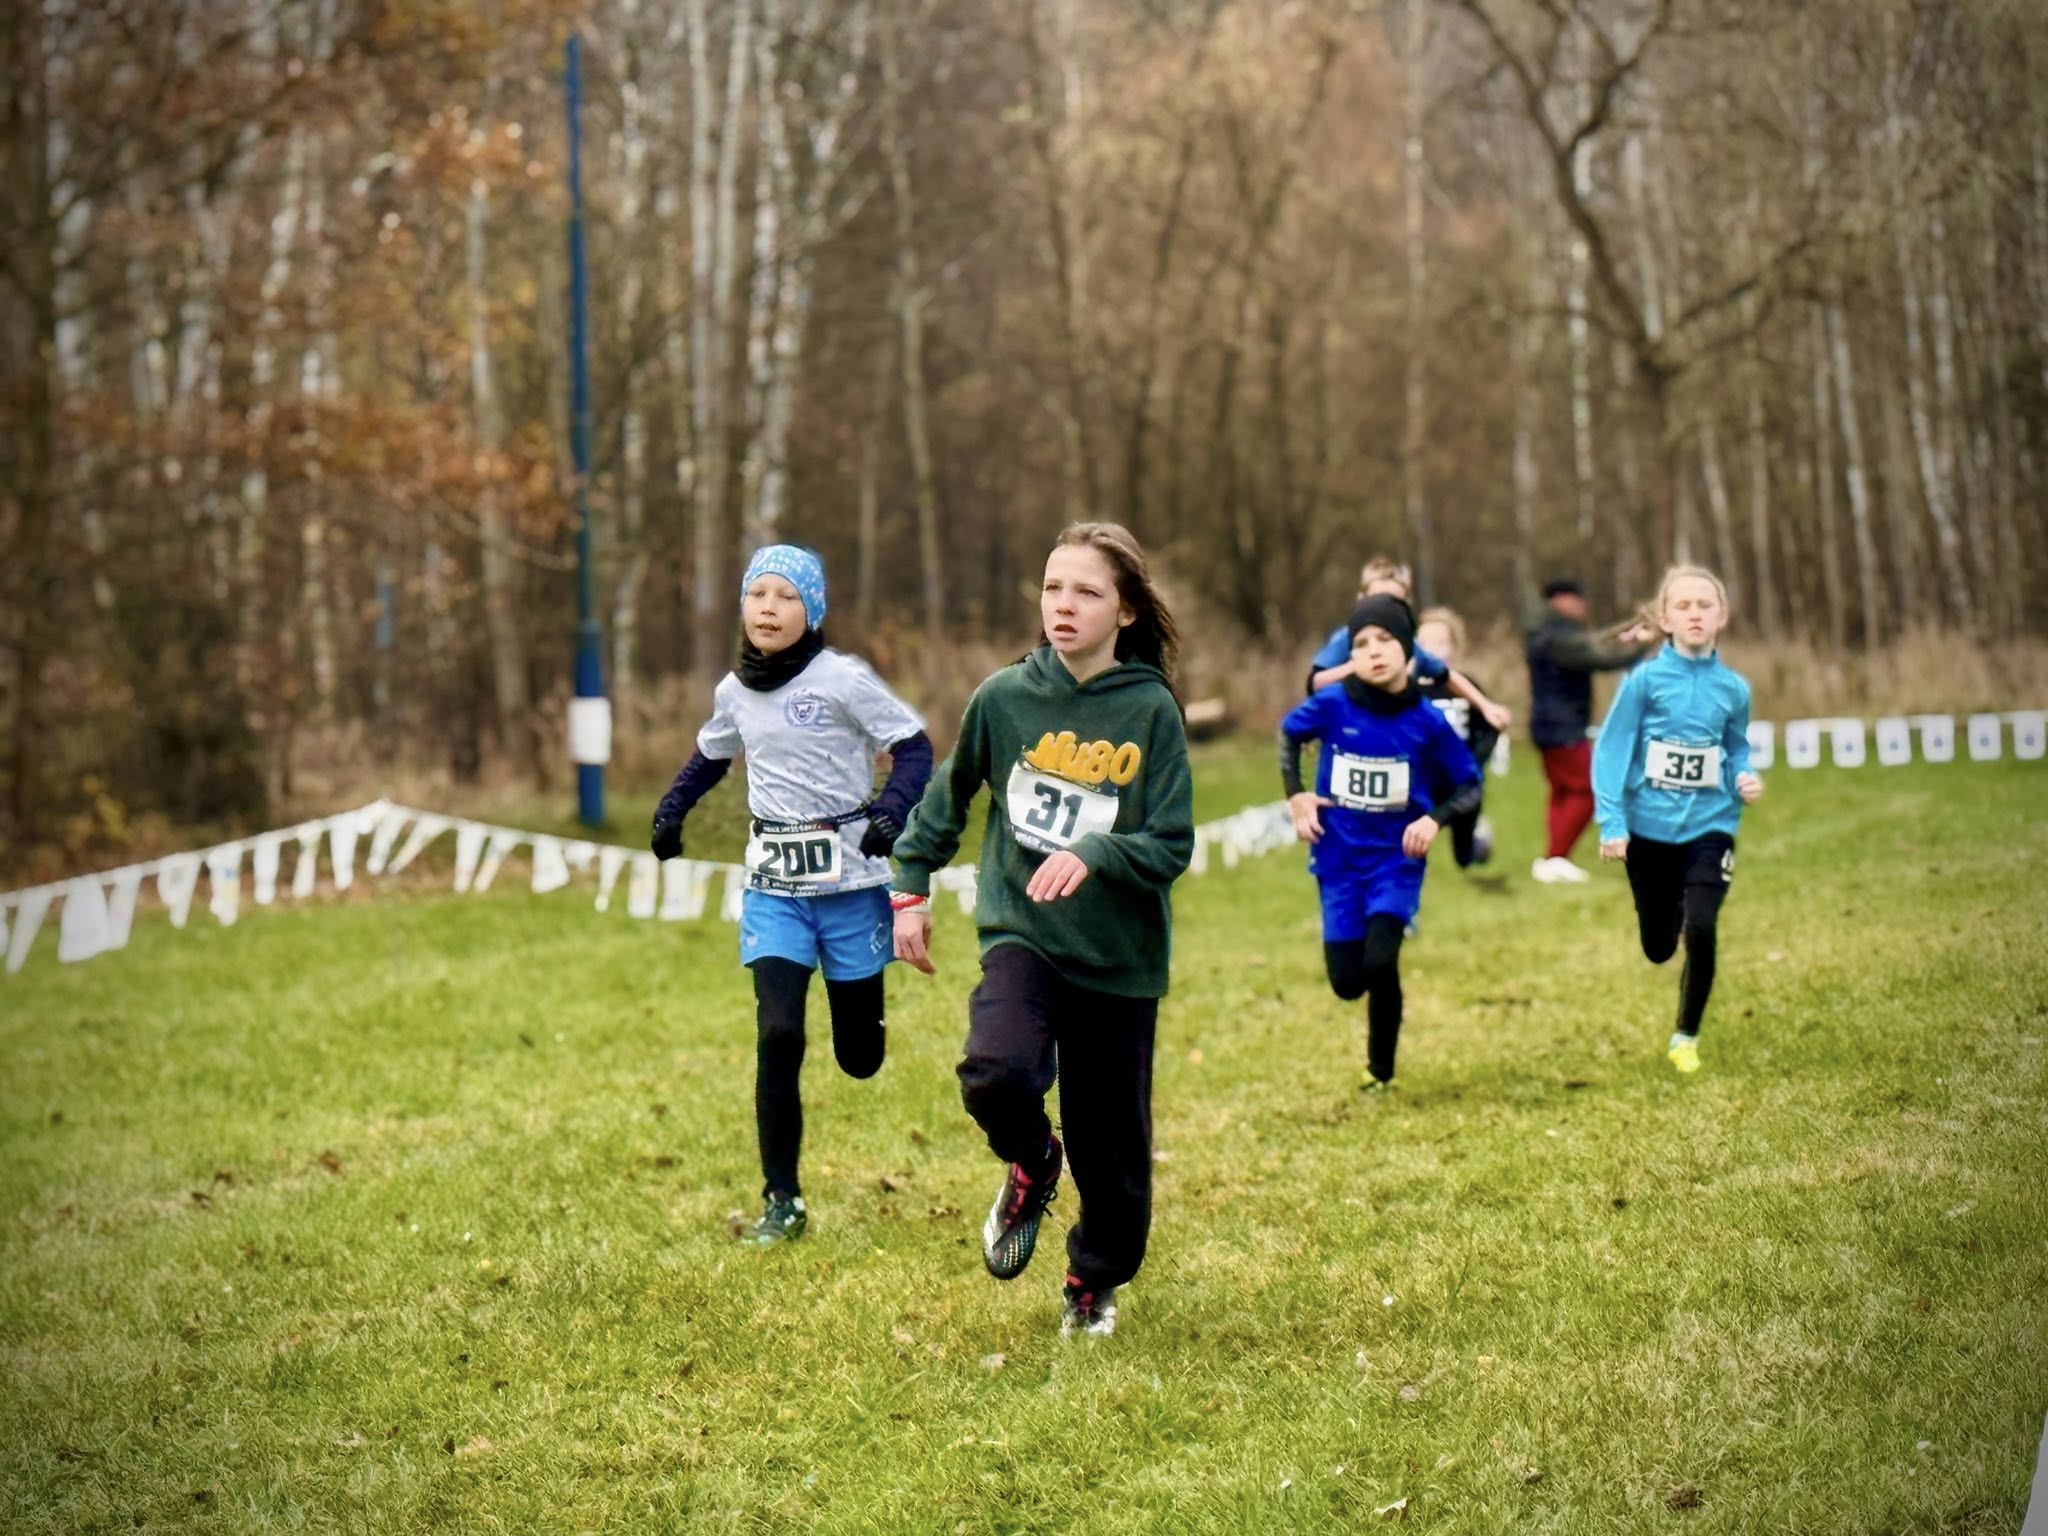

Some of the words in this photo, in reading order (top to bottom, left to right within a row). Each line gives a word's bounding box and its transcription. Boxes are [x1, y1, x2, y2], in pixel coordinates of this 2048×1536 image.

[1664, 751, 1705, 780] 33
[1348, 768, 1389, 798] 80
[1026, 781, 1083, 838] 31
[758, 838, 832, 877] 200
